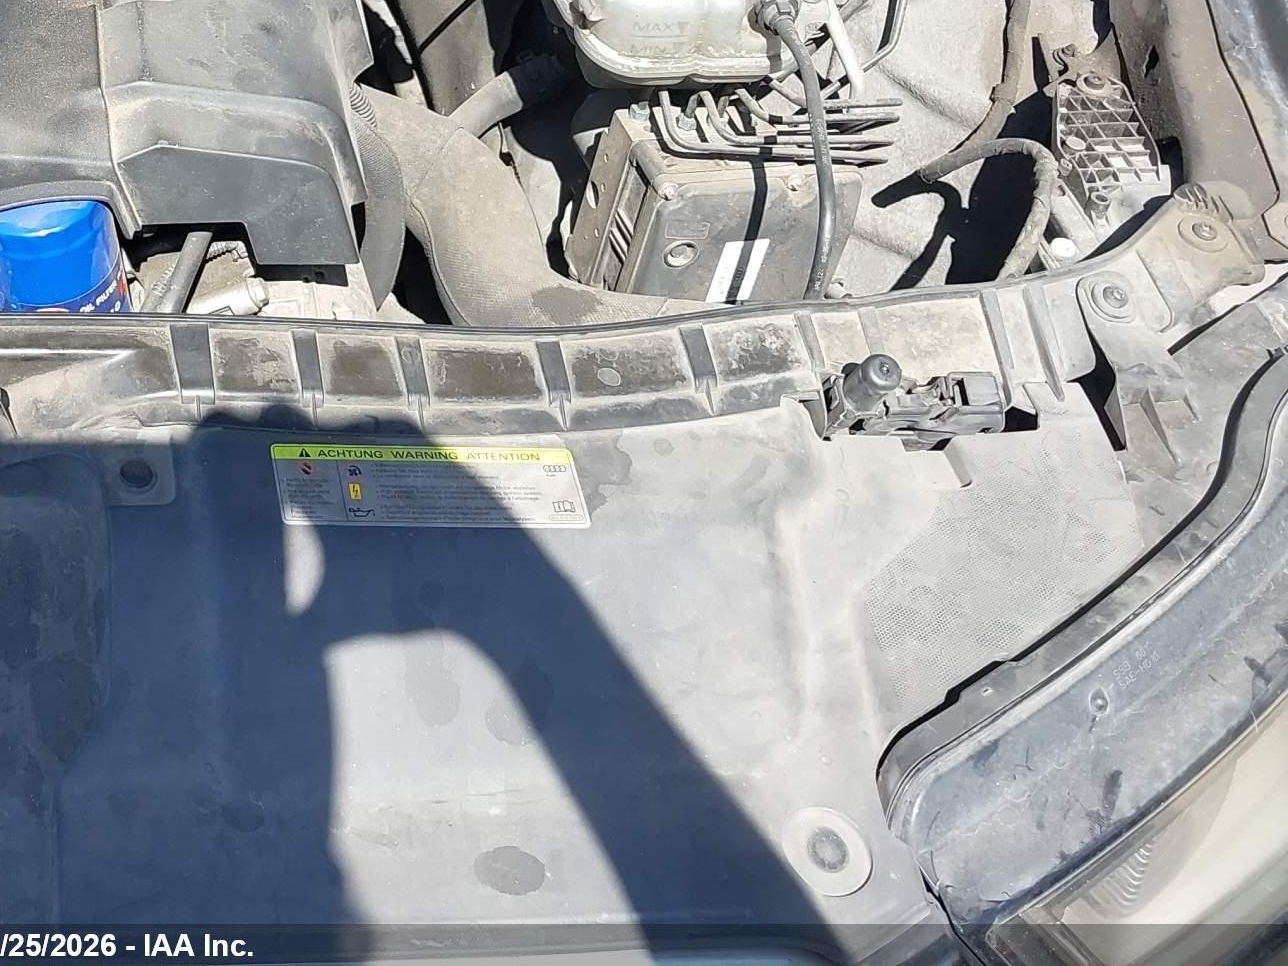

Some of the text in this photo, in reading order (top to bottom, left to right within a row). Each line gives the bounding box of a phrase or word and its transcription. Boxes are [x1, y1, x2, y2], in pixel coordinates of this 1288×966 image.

[632, 21, 675, 34] MAX
[316, 448, 541, 462] ACHTUNG WARNING ATTENTION
